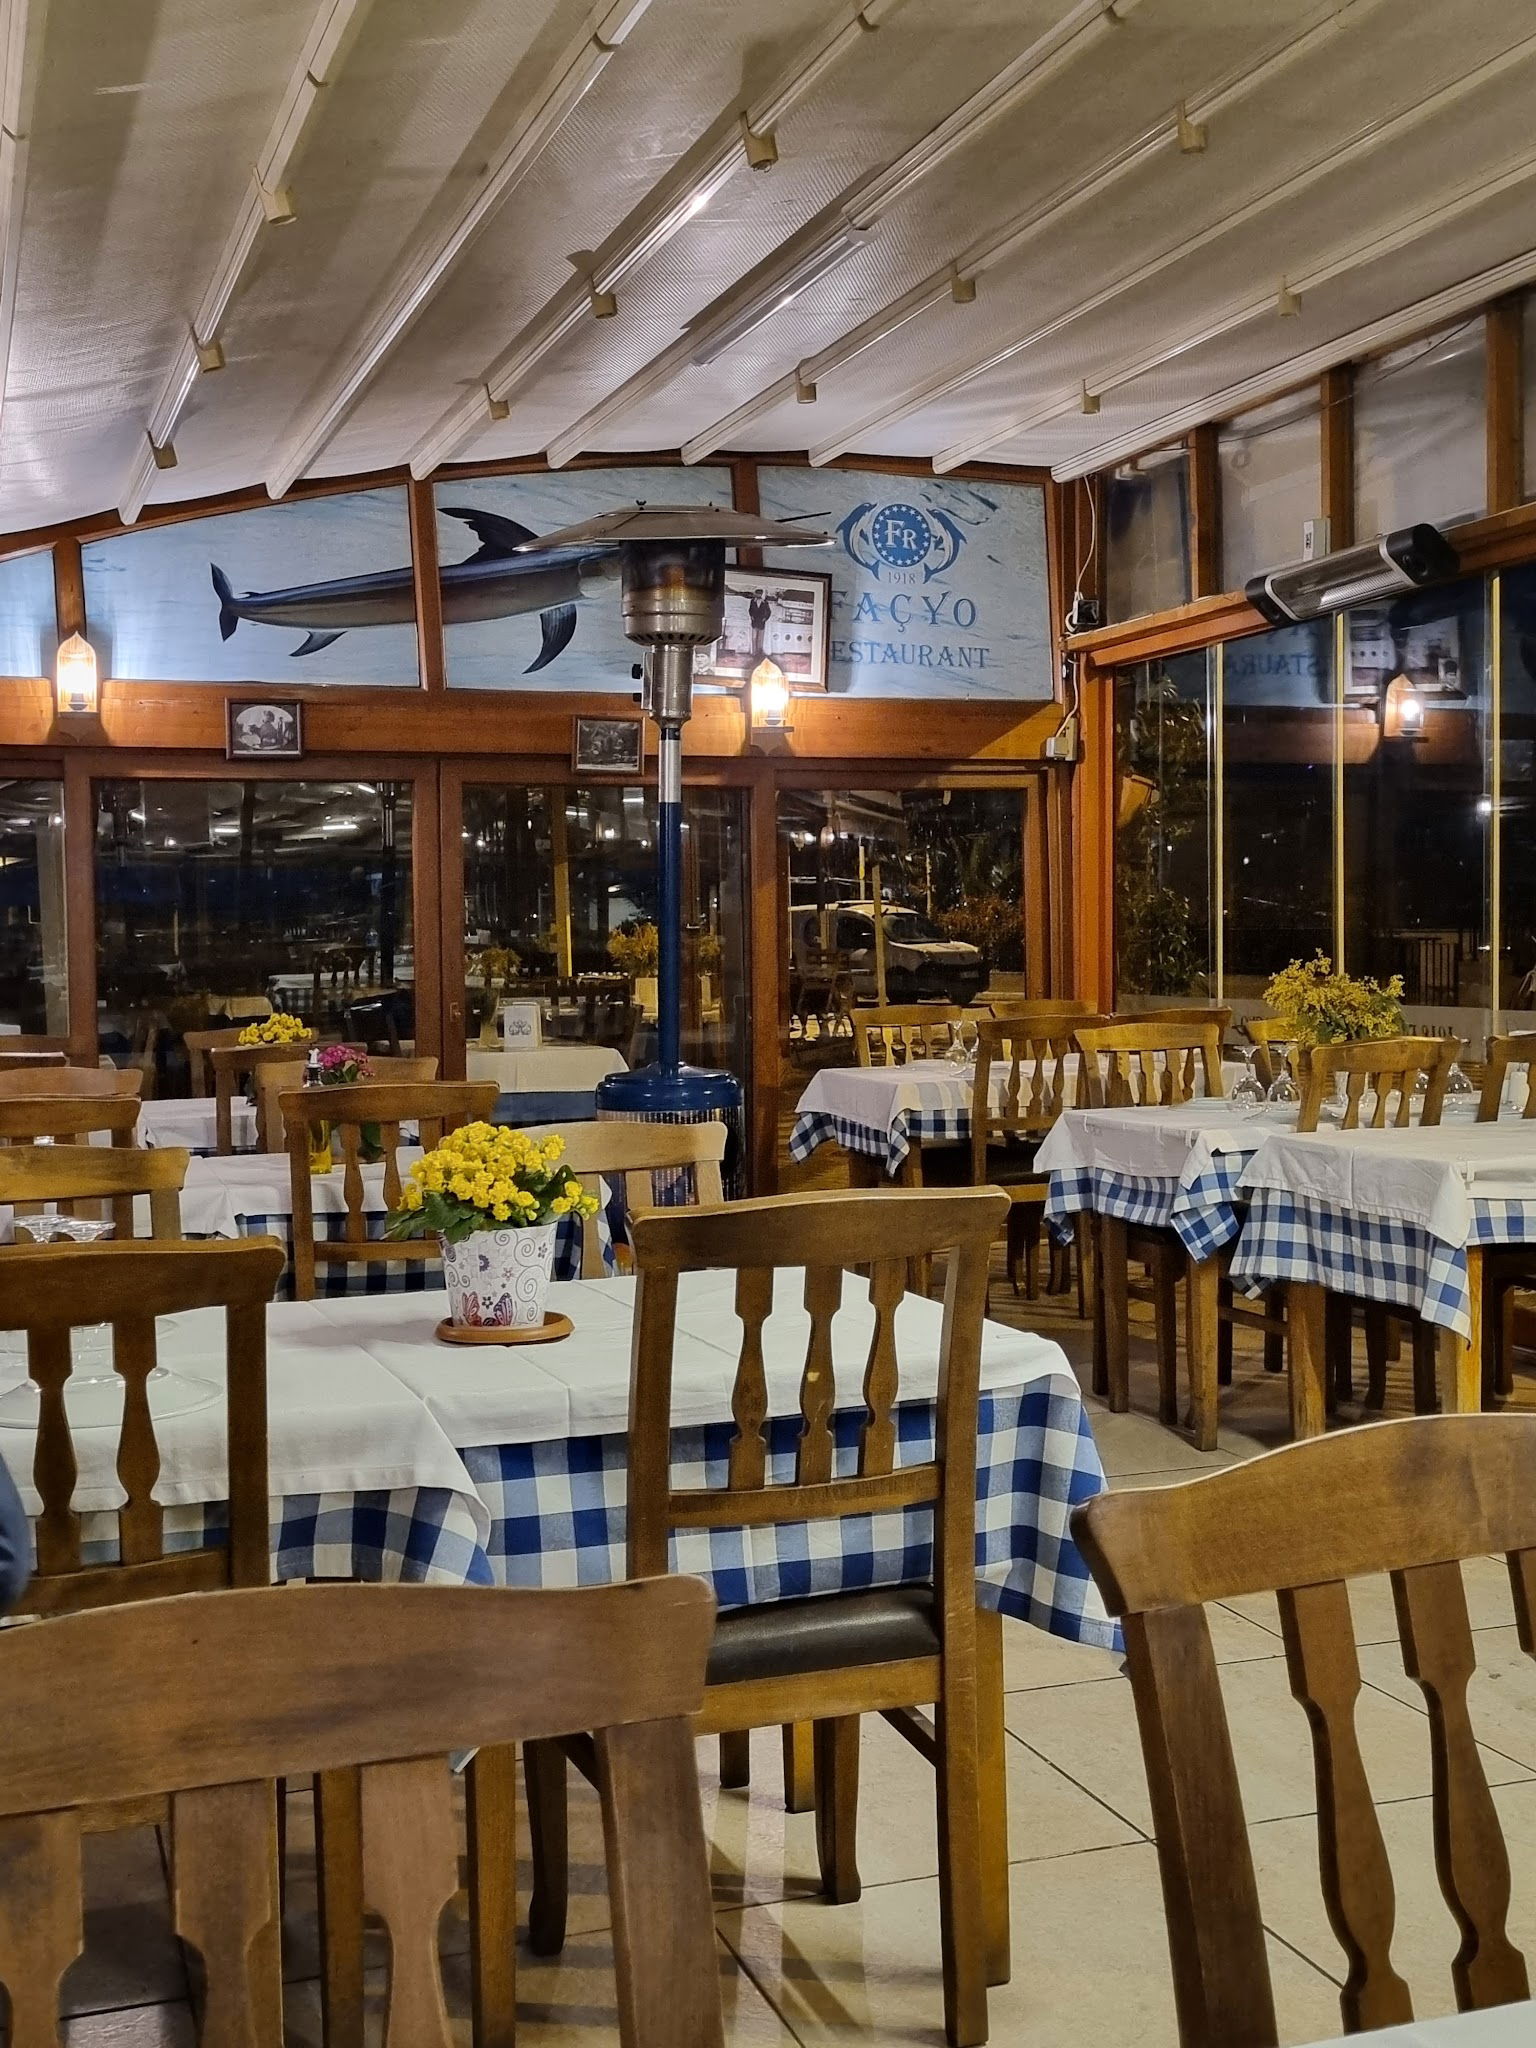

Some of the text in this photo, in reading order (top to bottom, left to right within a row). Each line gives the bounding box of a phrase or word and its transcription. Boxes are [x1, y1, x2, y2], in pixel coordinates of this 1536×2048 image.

[885, 519, 918, 551] FR
[888, 571, 916, 585] 1918
[831, 590, 976, 632] FAÇYO
[831, 640, 990, 668] ESTAURANT
